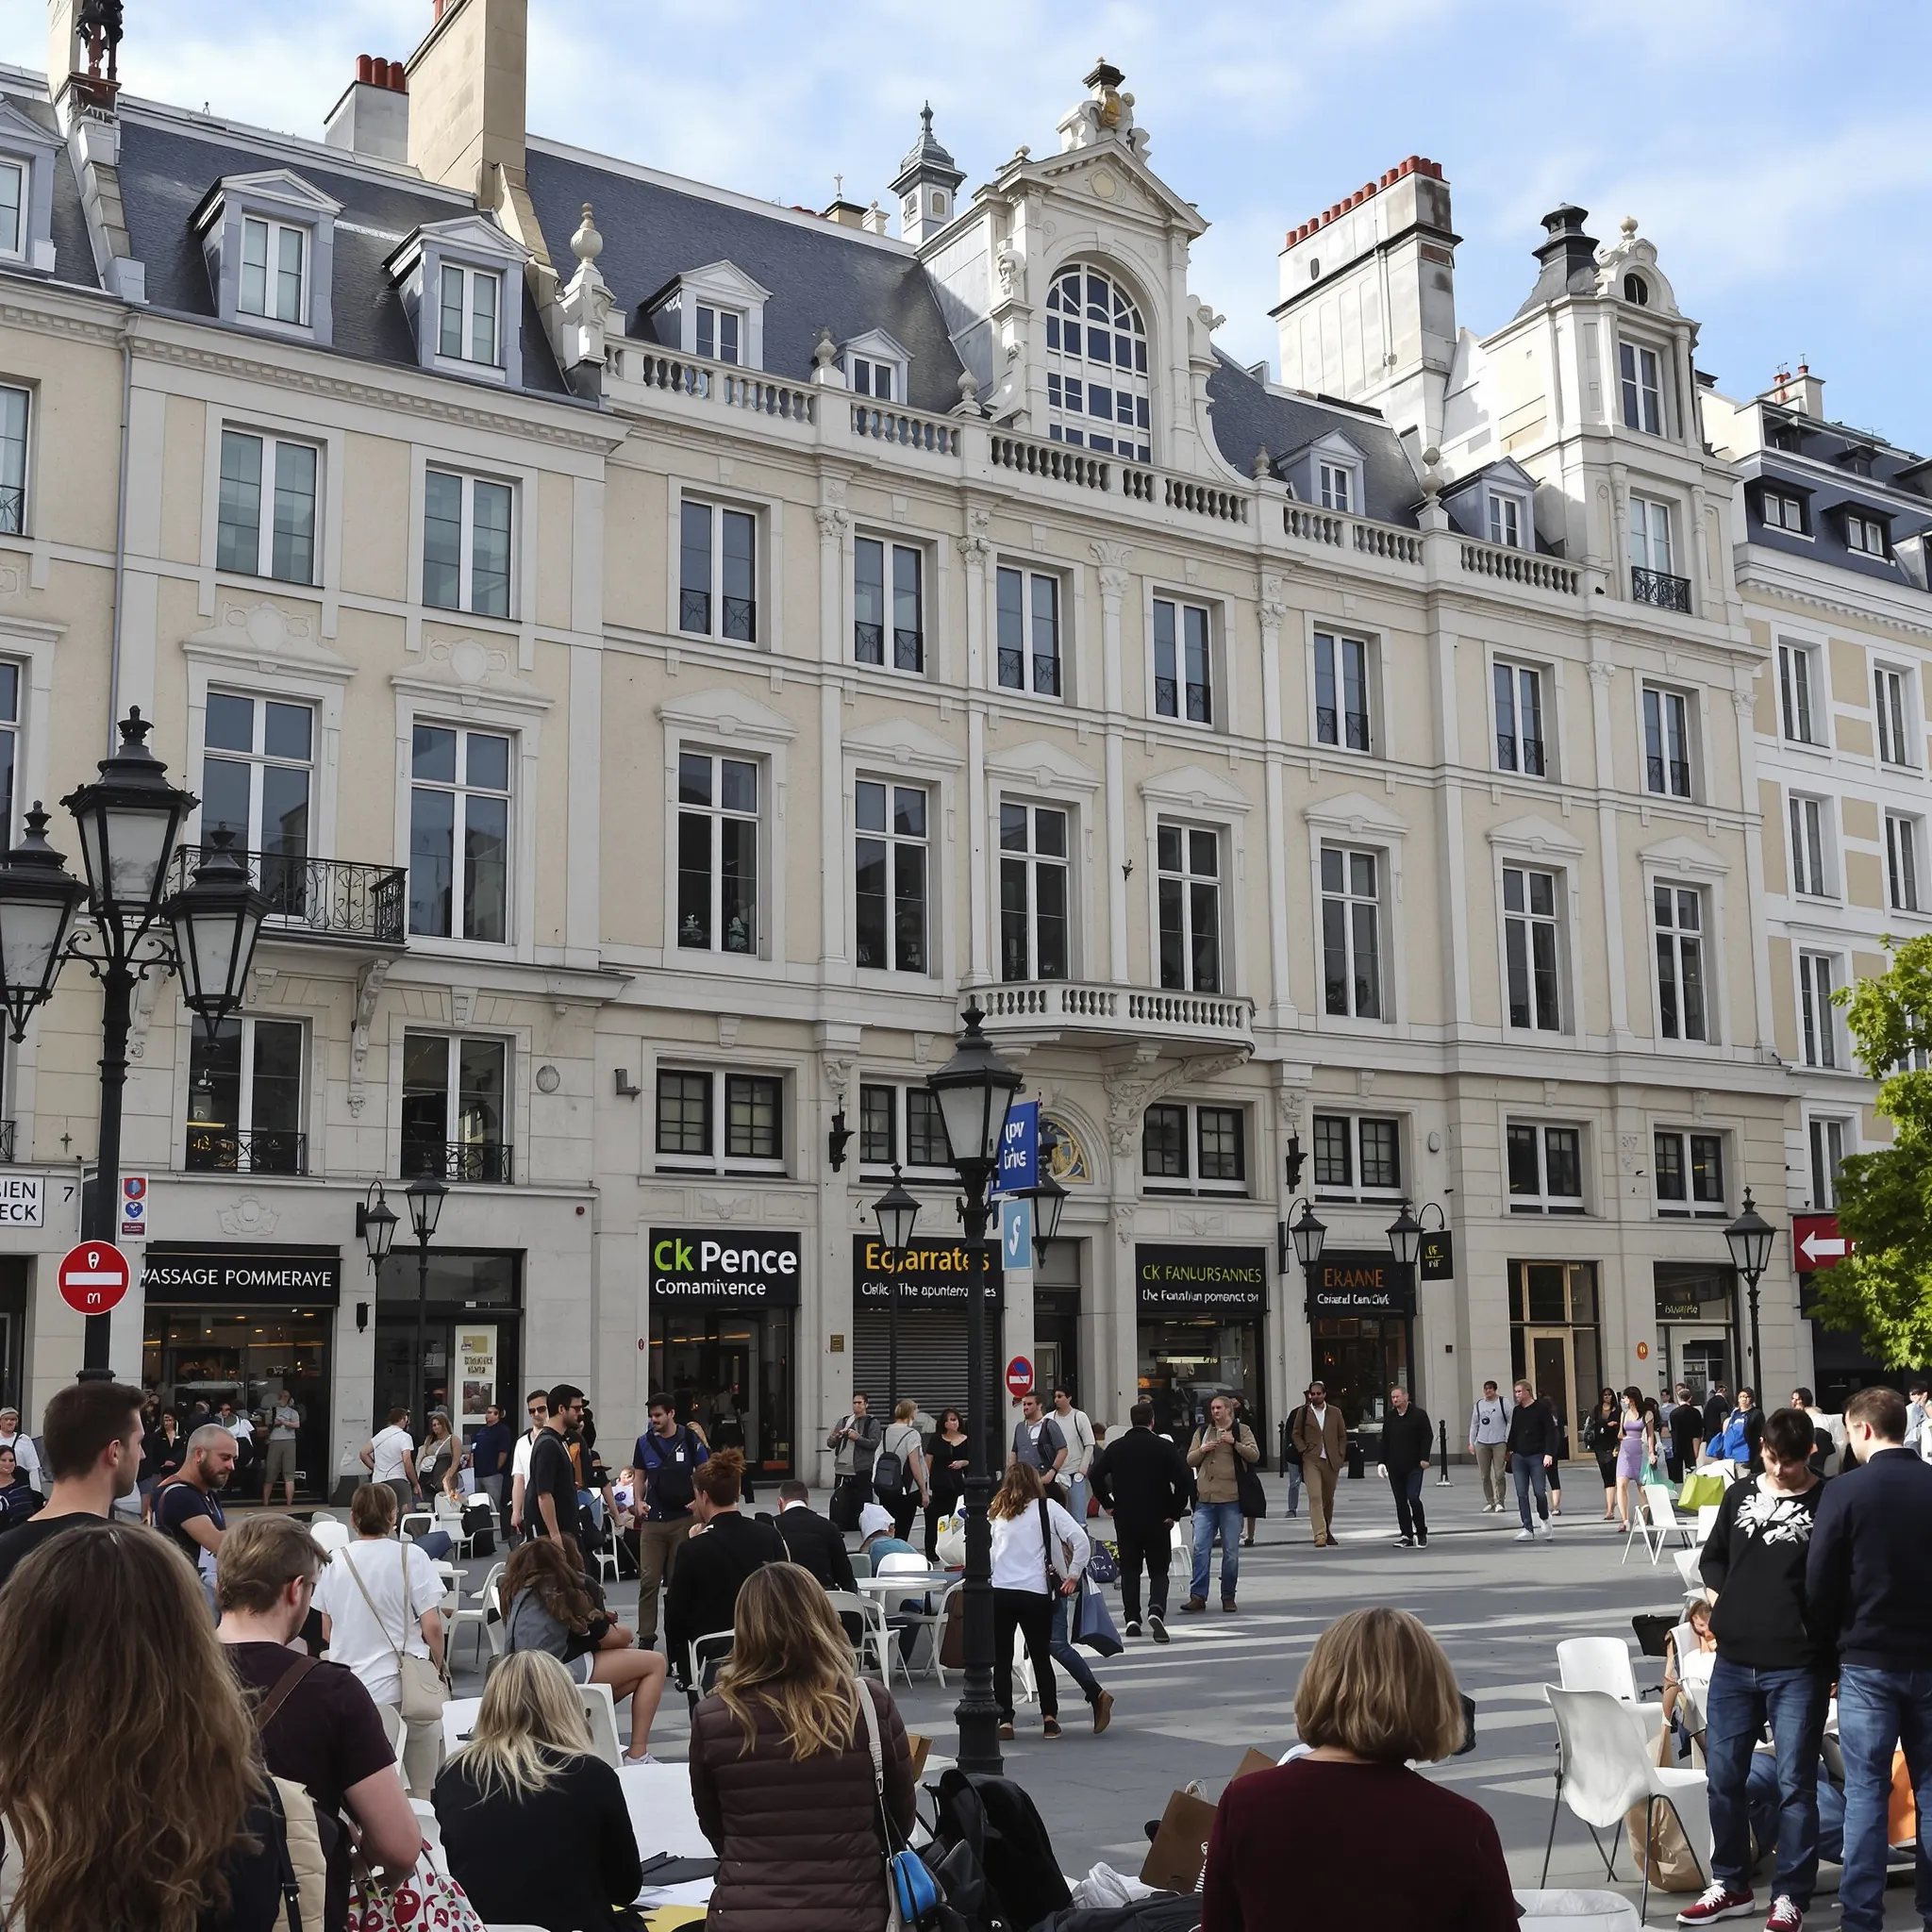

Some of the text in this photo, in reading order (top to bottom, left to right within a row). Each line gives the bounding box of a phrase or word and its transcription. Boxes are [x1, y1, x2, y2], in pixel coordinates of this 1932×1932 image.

[0, 1181, 36, 1199] IEN
[63, 1186, 75, 1203] 7
[0, 1204, 37, 1221] ECK
[654, 1238, 797, 1274] Ck Pence
[225, 1270, 332, 1287] POMMERAYE
[1142, 1264, 1161, 1280] CK
